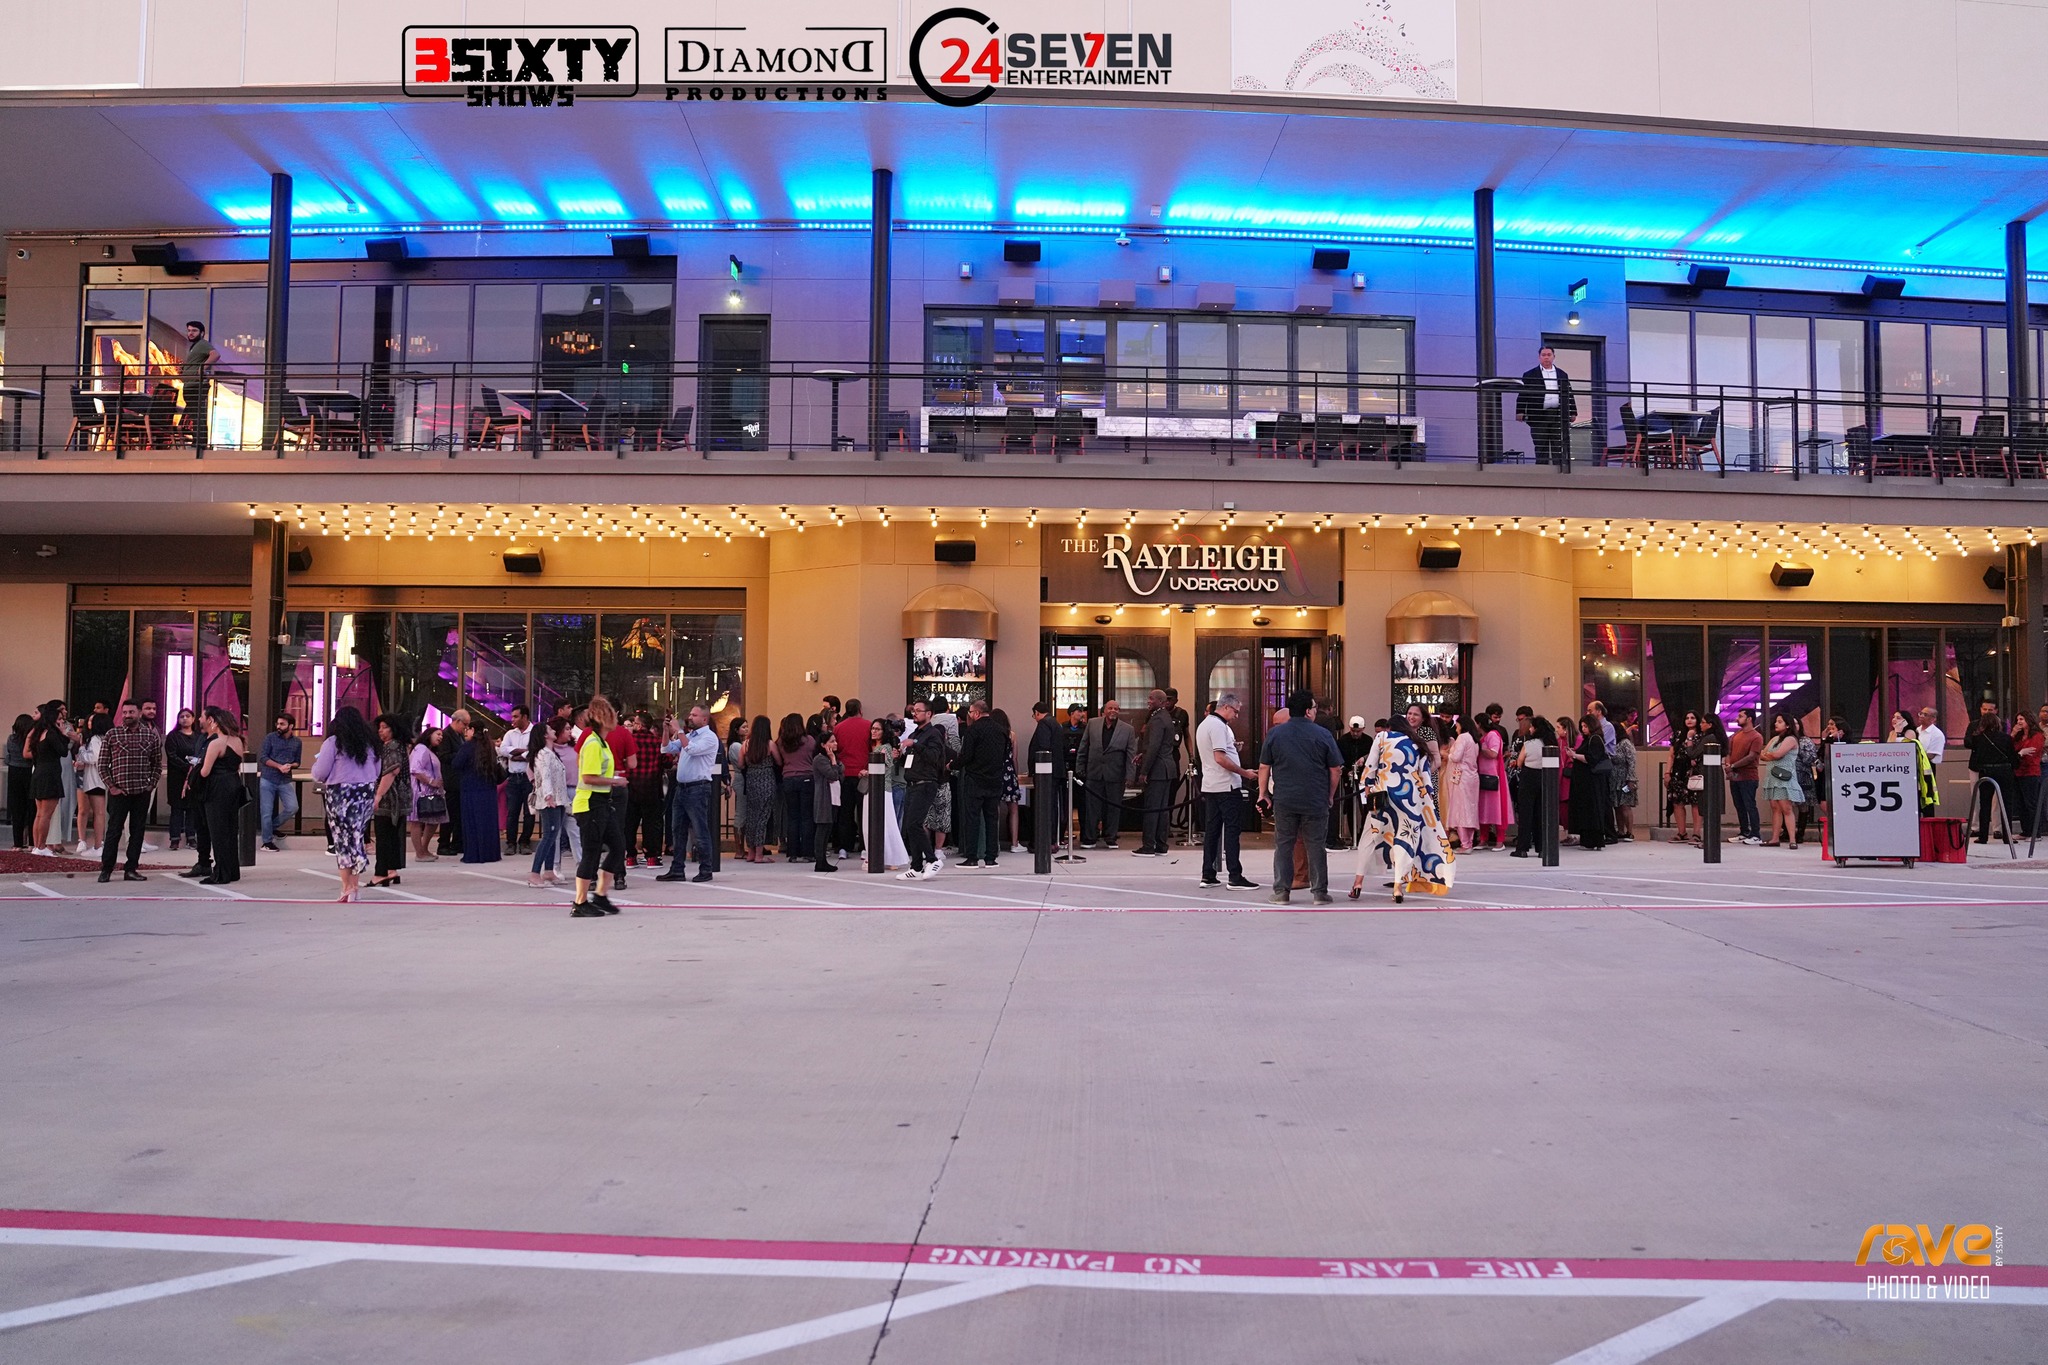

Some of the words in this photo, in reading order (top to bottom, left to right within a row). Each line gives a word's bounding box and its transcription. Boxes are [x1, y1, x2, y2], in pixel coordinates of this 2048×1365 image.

[1061, 539, 1099, 553] THE
[1102, 533, 1286, 596] RAYLEIGH
[1170, 577, 1279, 592] UNDERGROUND
[931, 683, 968, 692] FRIDAY
[1407, 685, 1442, 694] FRIDAY
[1406, 695, 1444, 704] 4.19.24
[1838, 765, 1865, 774] Valet
[1869, 764, 1910, 774] Parking
[1841, 781, 1903, 812] $35
[928, 1247, 1115, 1271] PARKING
[1144, 1257, 1202, 1274] NO
[1319, 1261, 1440, 1277] LANE
[1465, 1261, 1574, 1278] FIRE
